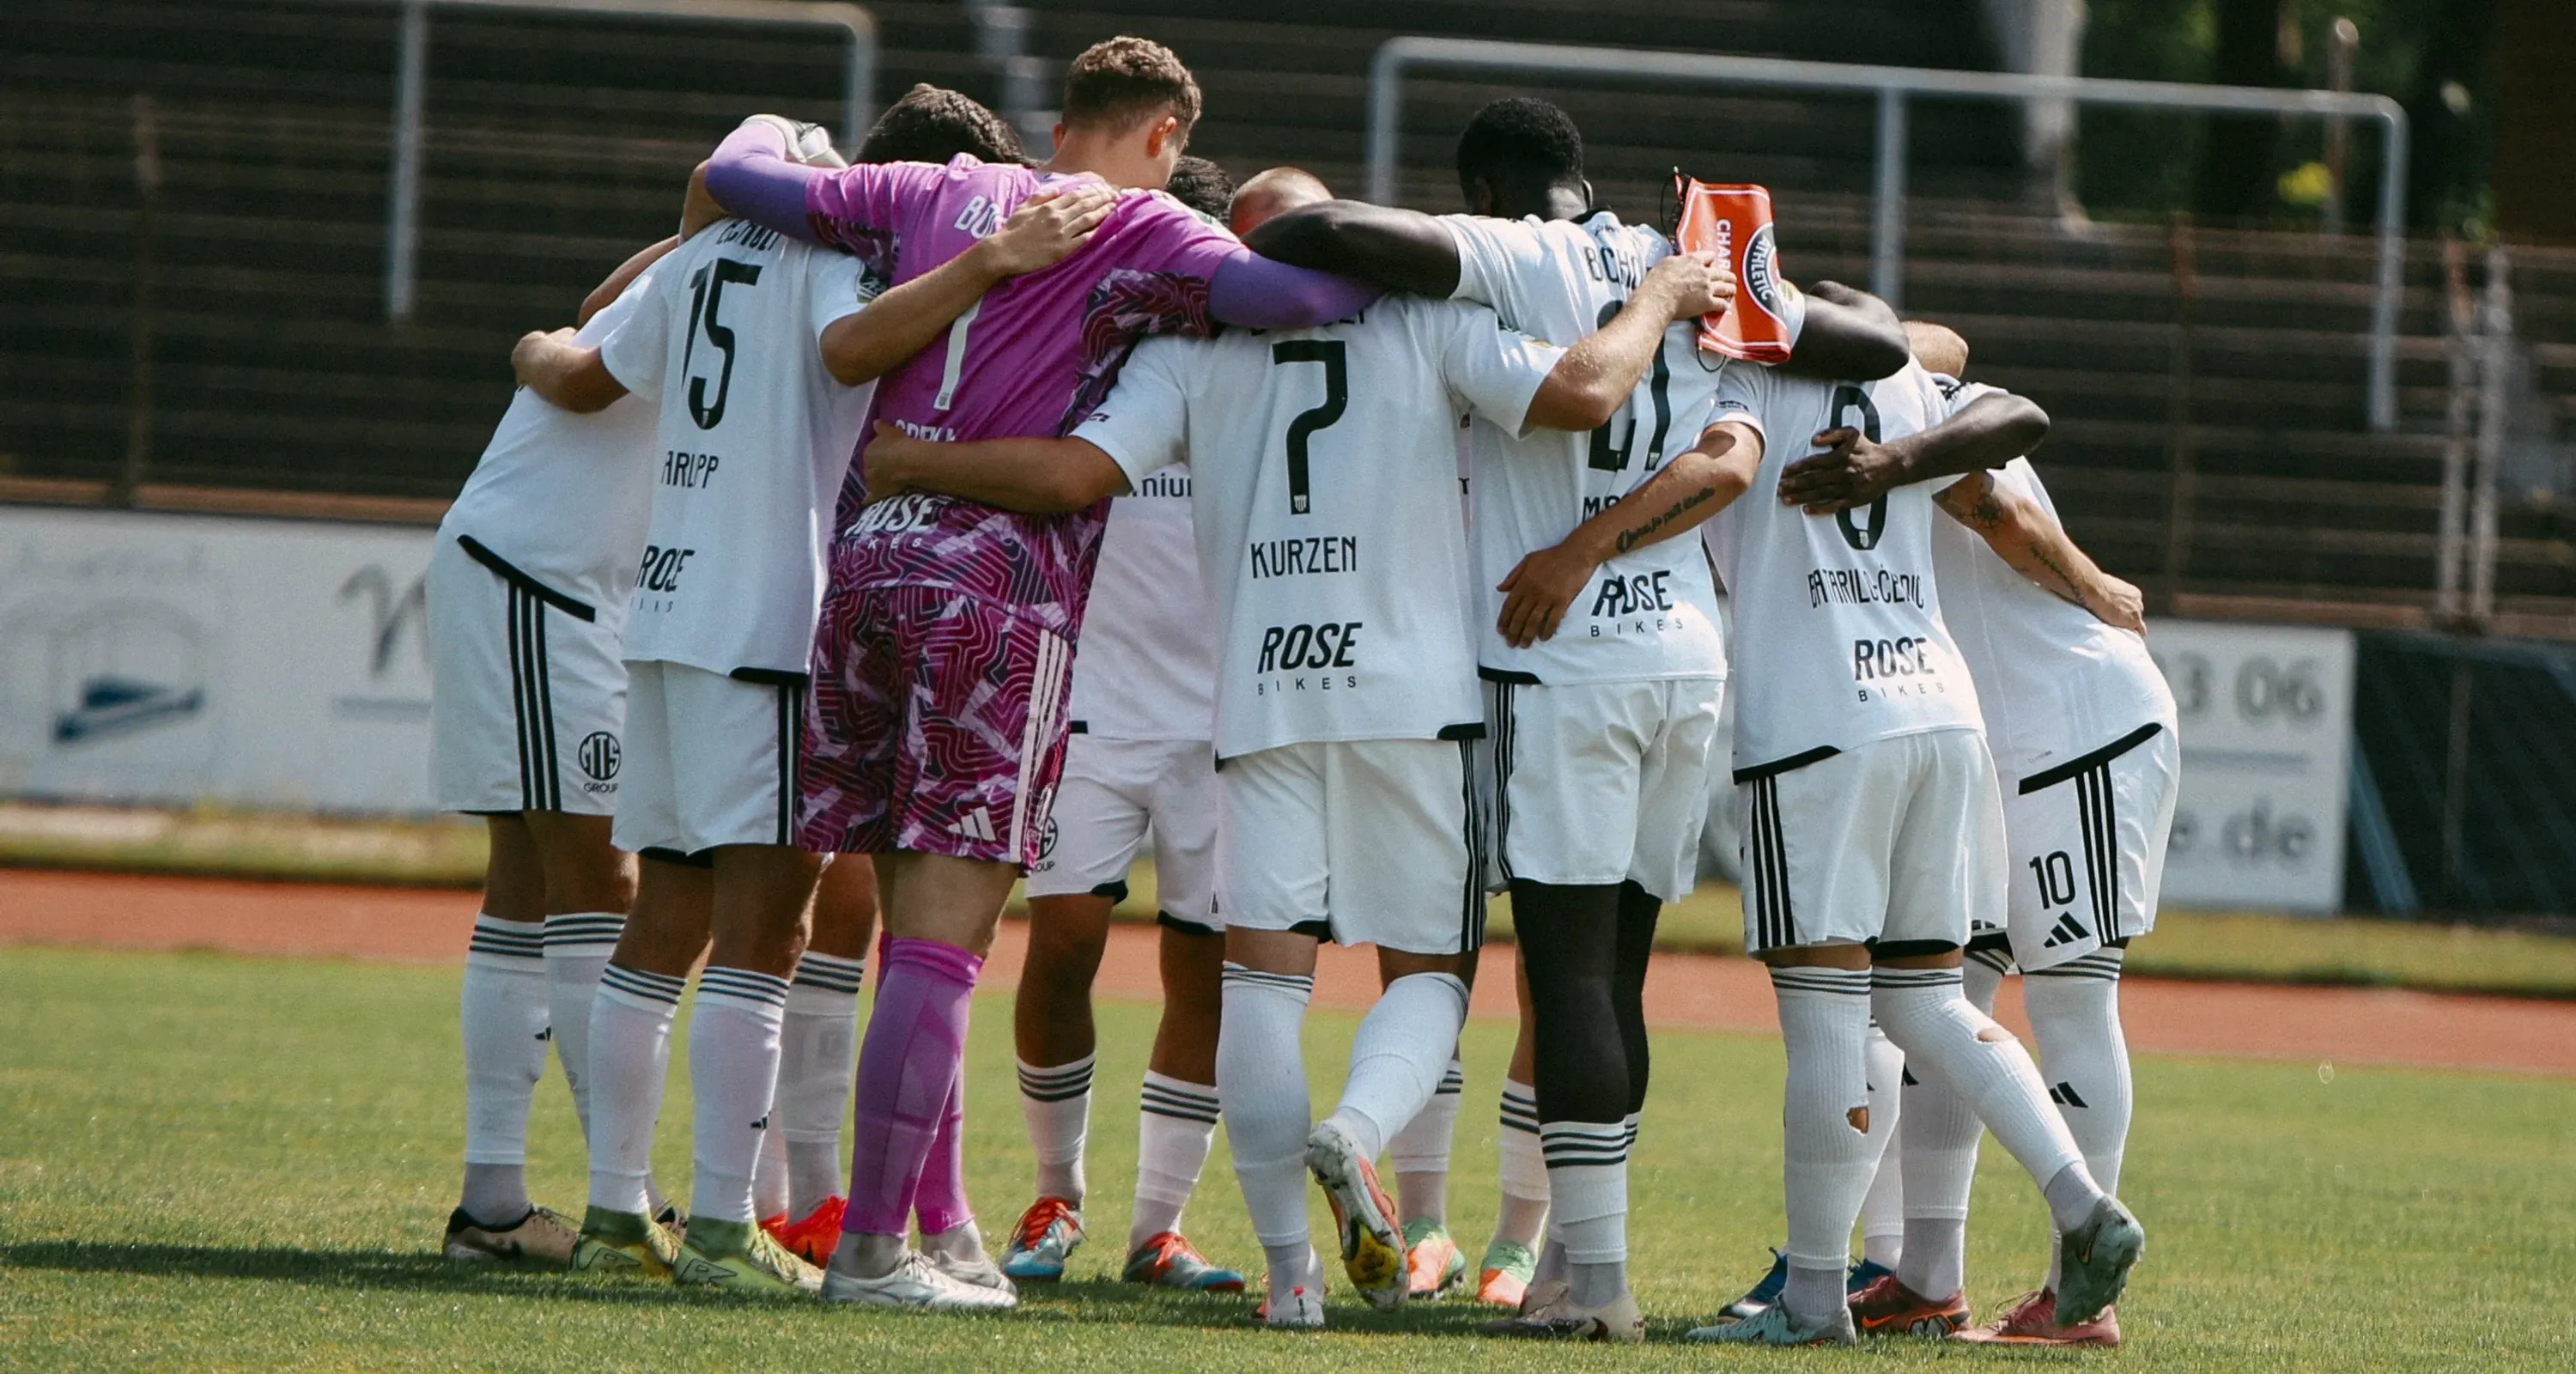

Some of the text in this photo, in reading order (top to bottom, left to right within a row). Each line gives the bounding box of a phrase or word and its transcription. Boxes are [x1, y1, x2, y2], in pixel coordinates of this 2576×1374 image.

[1716, 218, 1732, 271] CHAR
[1750, 234, 1775, 301] ATHLETIC
[681, 258, 763, 430] 15
[1272, 340, 1348, 515] 7
[1250, 536, 1357, 580] KURZEN
[1257, 622, 1363, 674] ROSE
[1590, 617, 1684, 637] BIKES
[1854, 636, 1935, 681] ROSE
[1257, 676, 1357, 696] BIKES
[1857, 683, 1945, 702] BIKES
[2028, 850, 2076, 910] 10
